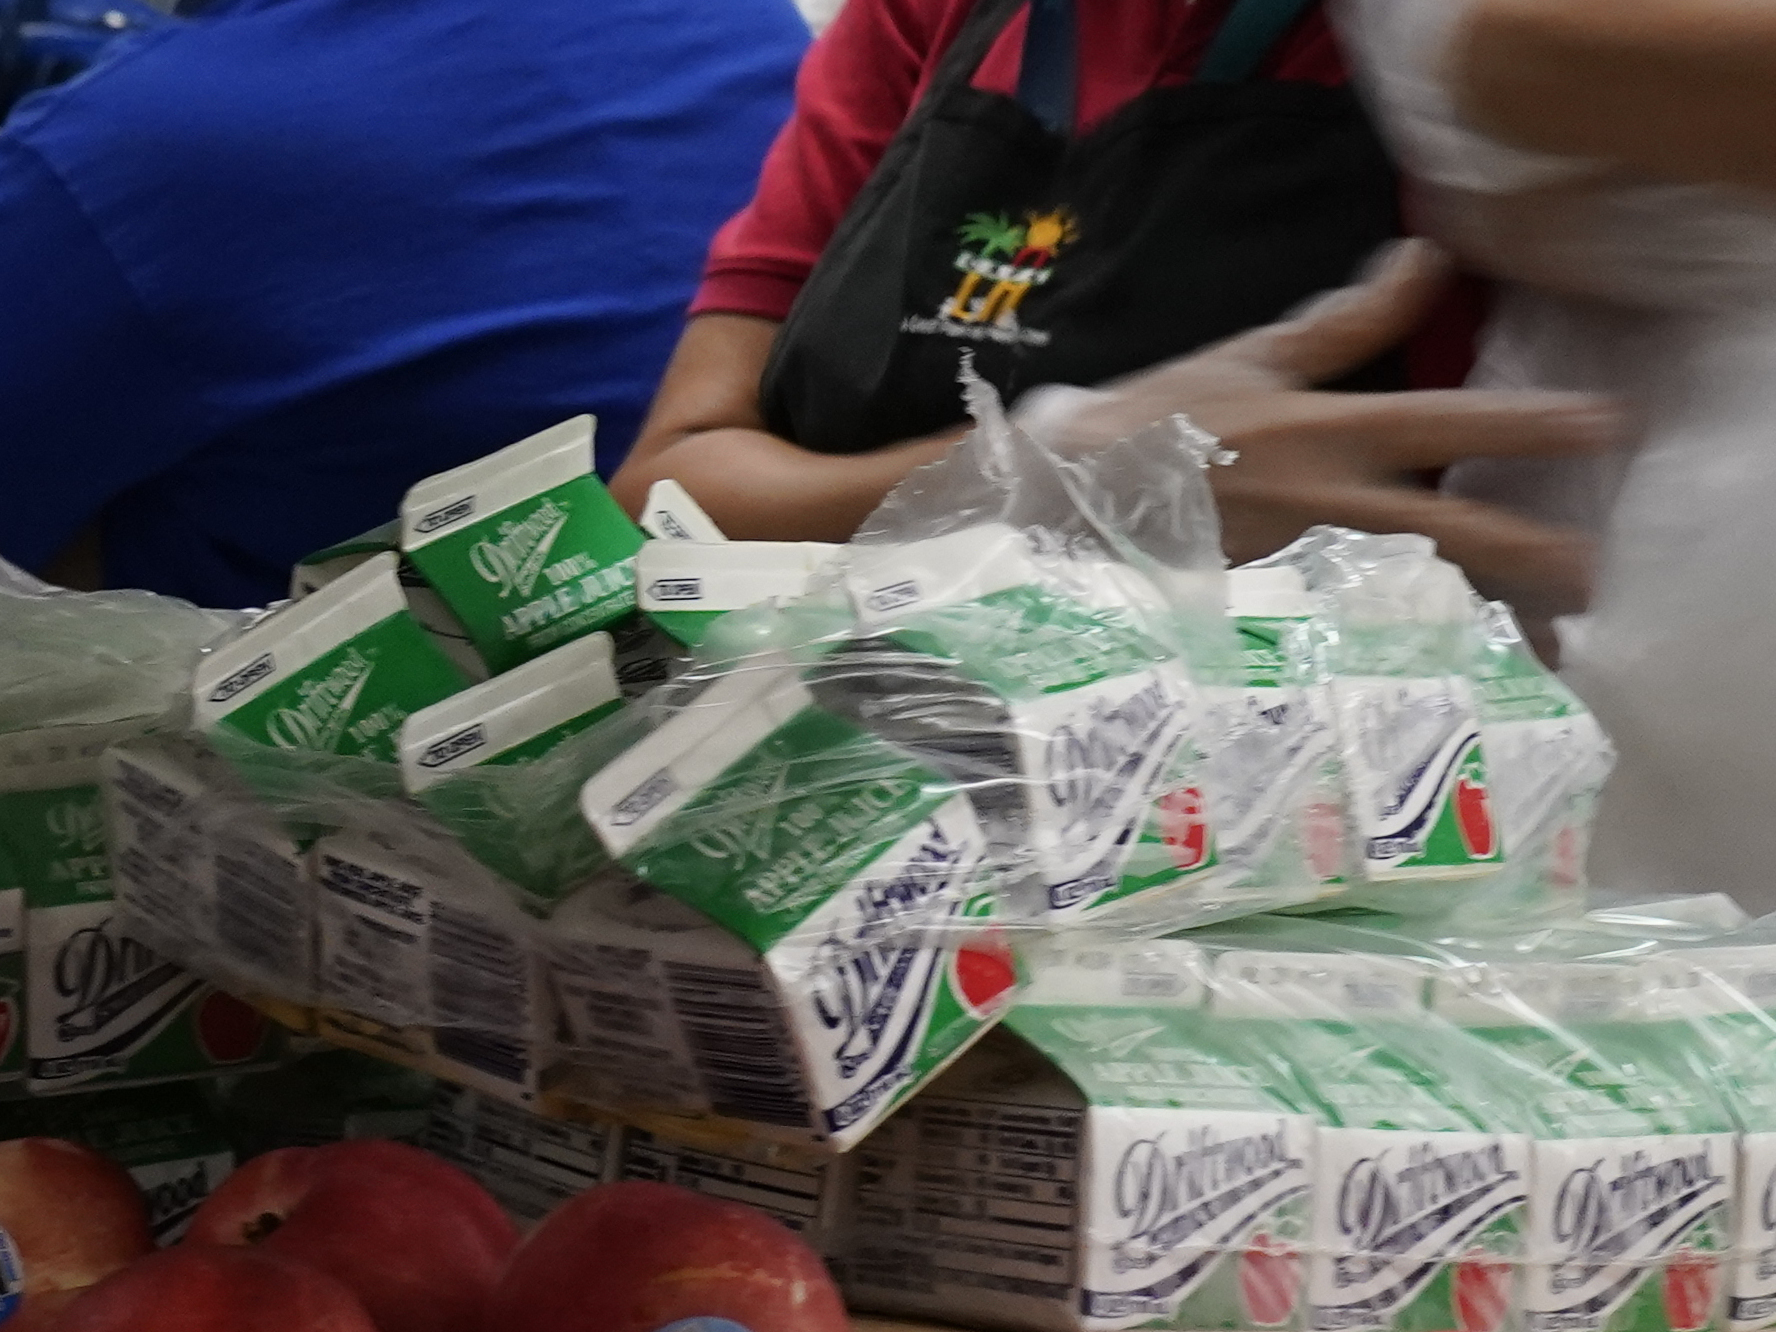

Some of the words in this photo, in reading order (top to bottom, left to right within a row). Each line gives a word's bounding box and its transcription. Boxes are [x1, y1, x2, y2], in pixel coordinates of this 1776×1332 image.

[501, 589, 582, 640] APPLE
[1115, 1118, 1288, 1250] Driftwood
[1337, 1141, 1506, 1251] Driftwood
[1555, 1139, 1714, 1258] Driftwood
